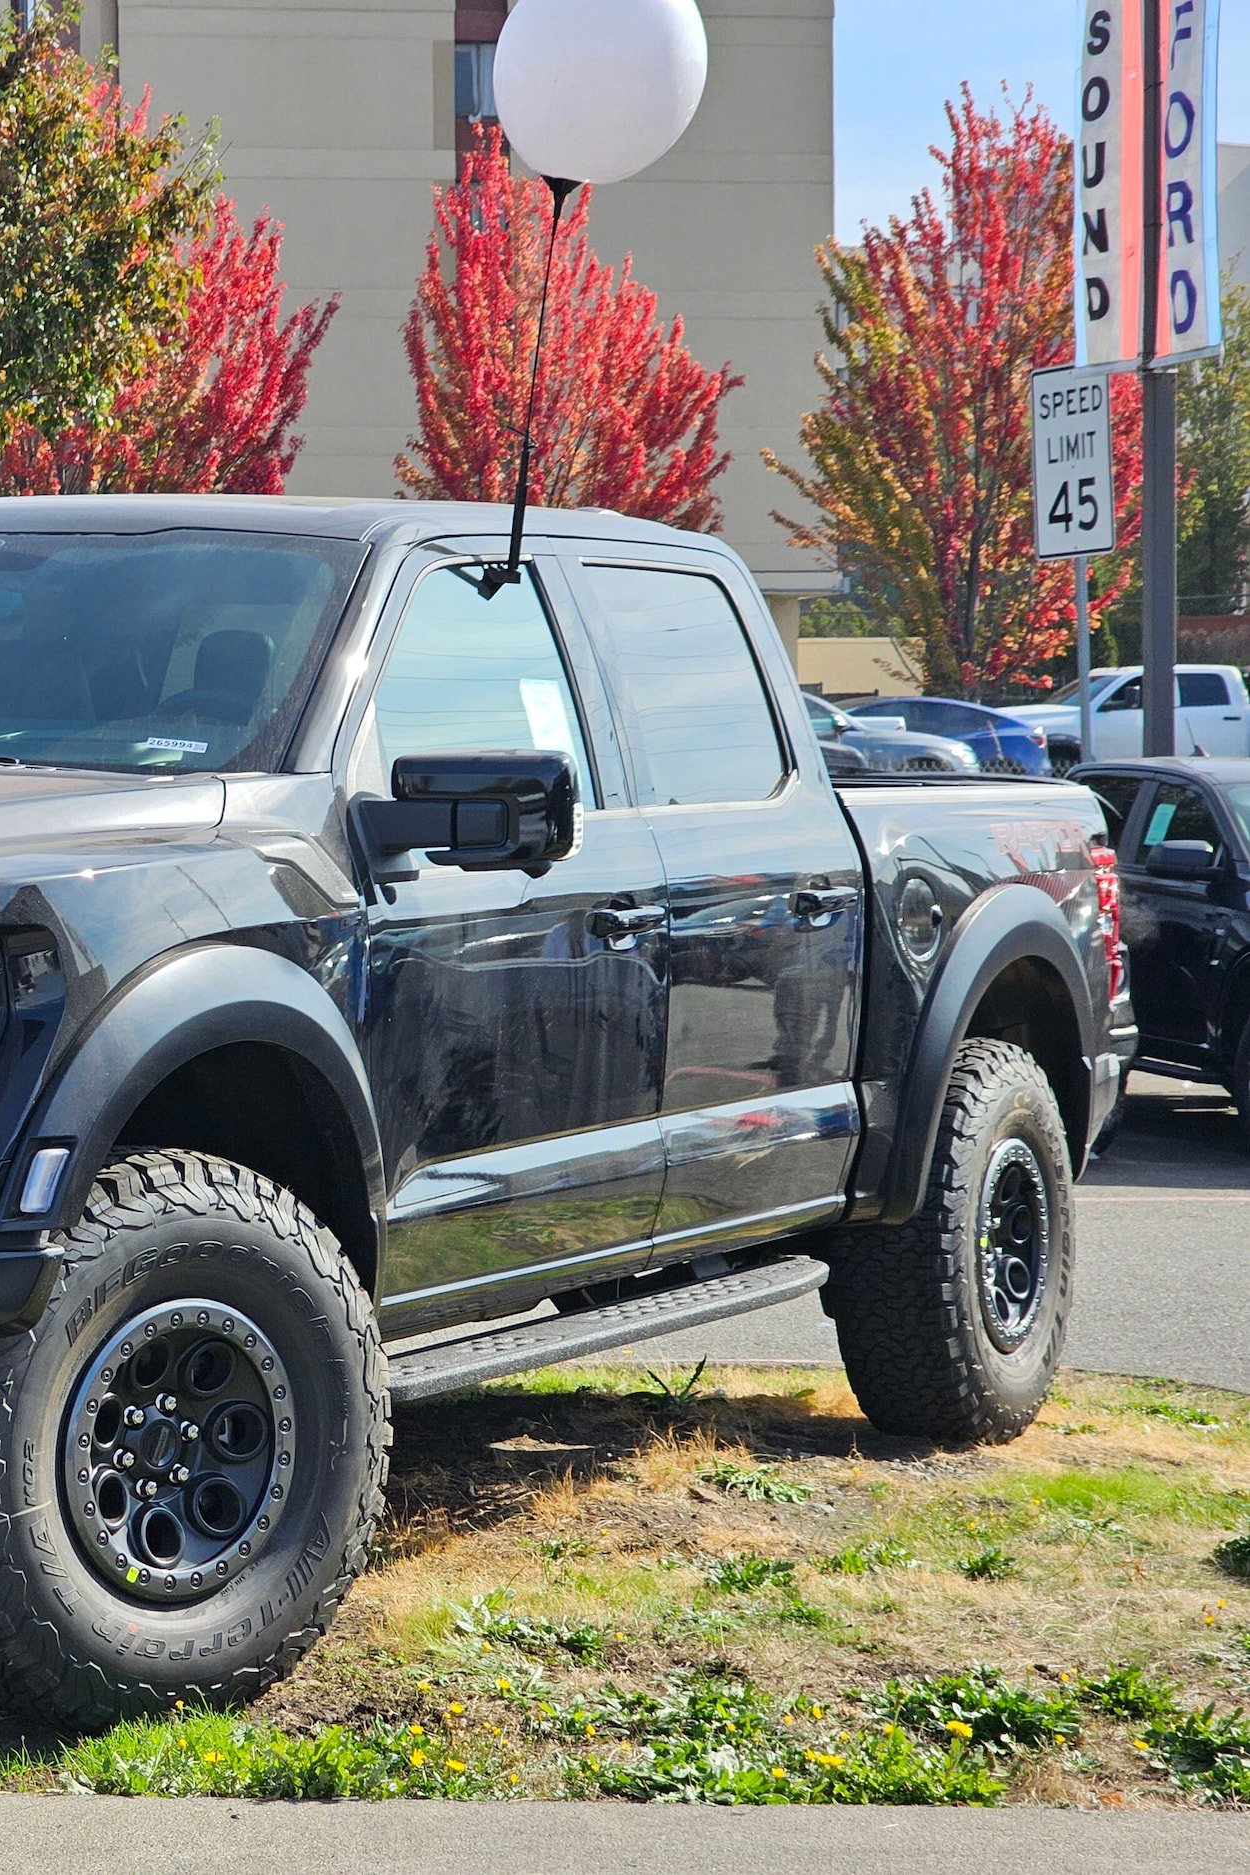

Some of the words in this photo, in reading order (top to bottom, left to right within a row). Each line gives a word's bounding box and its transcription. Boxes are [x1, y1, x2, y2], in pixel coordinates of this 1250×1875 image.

[1081, 10, 1111, 322] SOUND
[1164, 0, 1197, 335] FORD
[1039, 384, 1103, 420] SPEED
[1047, 430, 1097, 465] LIMIT
[1048, 476, 1099, 533] 45
[148, 738, 193, 749] 265994
[990, 821, 1096, 874] RAPTOR
[64, 1240, 334, 1348] BFGoodrich
[30, 1517, 82, 1617] T/A
[91, 1510, 332, 1661] All-Terrain
